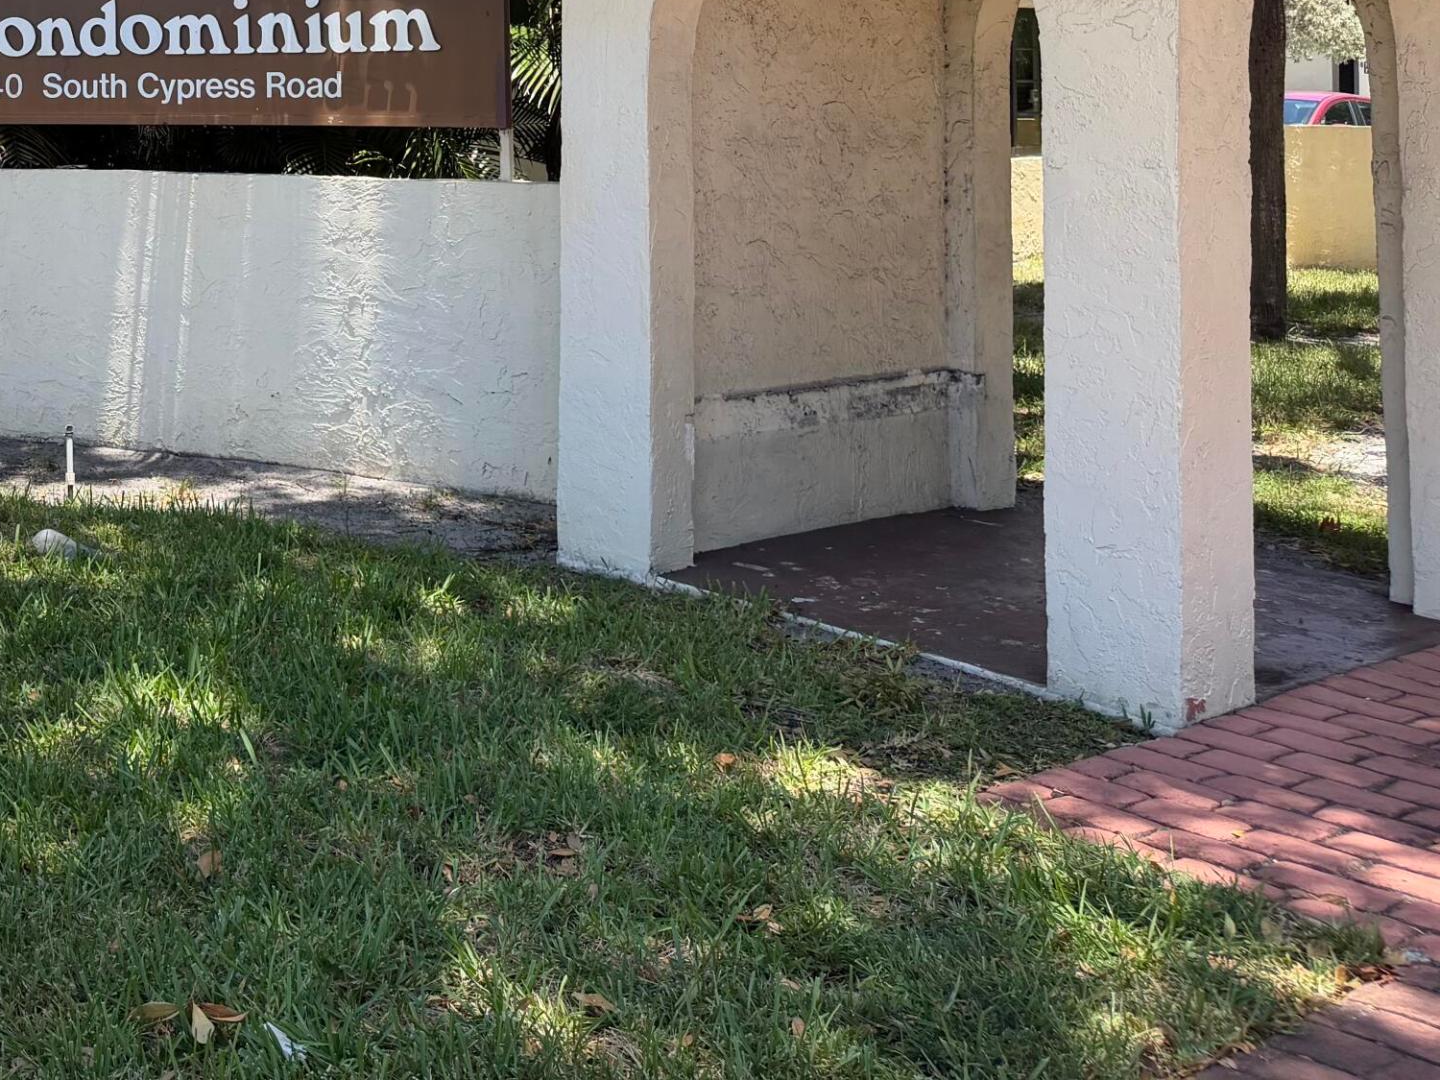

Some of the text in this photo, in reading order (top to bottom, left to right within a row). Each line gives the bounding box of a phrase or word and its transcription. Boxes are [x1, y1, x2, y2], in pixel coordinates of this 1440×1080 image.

[42, 71, 127, 100] South
[137, 71, 256, 105] Cypress
[266, 70, 343, 99] Road
